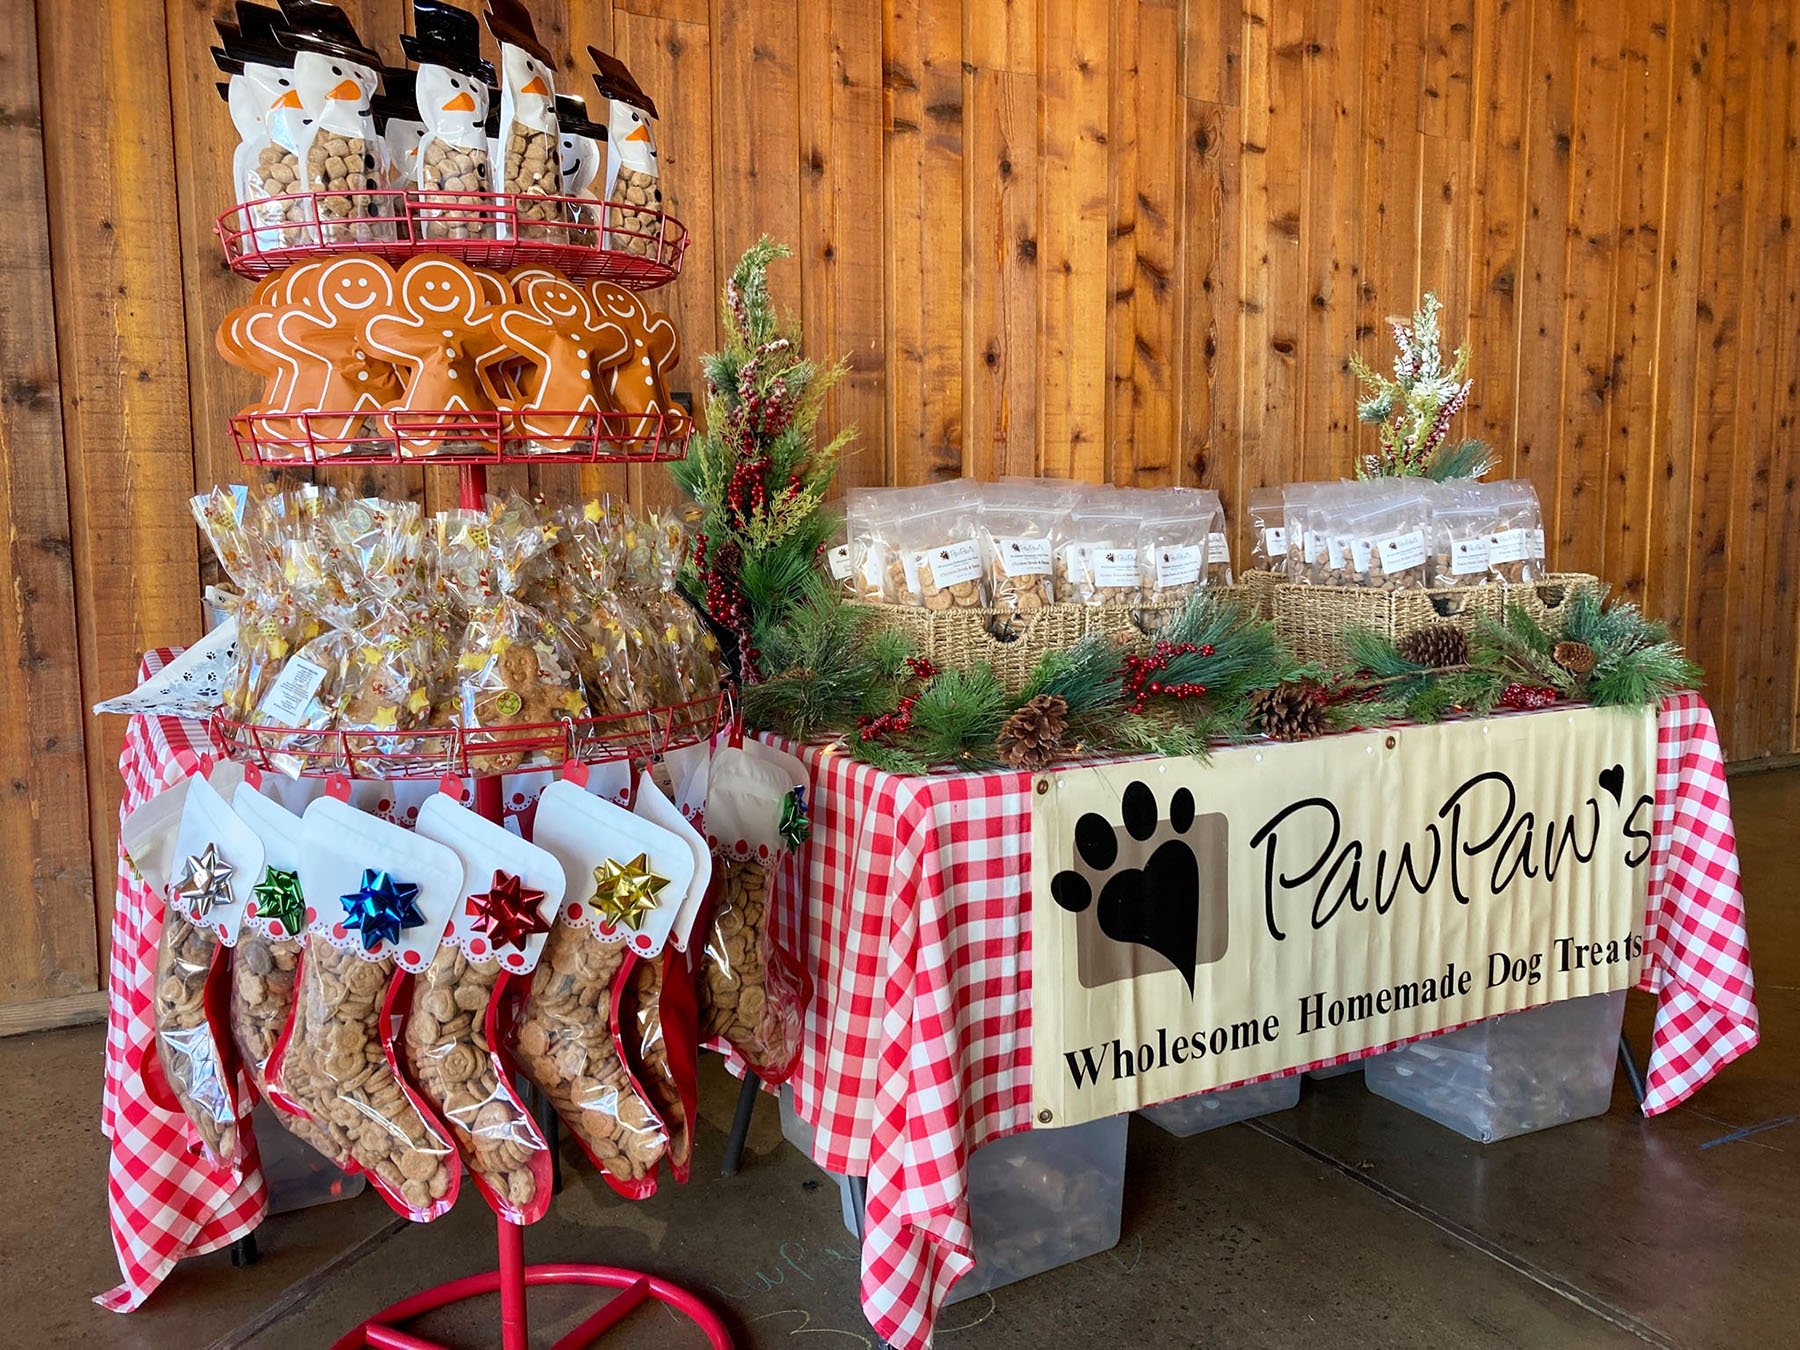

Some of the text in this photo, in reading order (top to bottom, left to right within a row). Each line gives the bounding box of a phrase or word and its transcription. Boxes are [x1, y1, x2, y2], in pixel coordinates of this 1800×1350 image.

[1249, 764, 1653, 942] PawPaw's
[1063, 930, 1644, 1089] Wholesome Homemade Dog Treats
